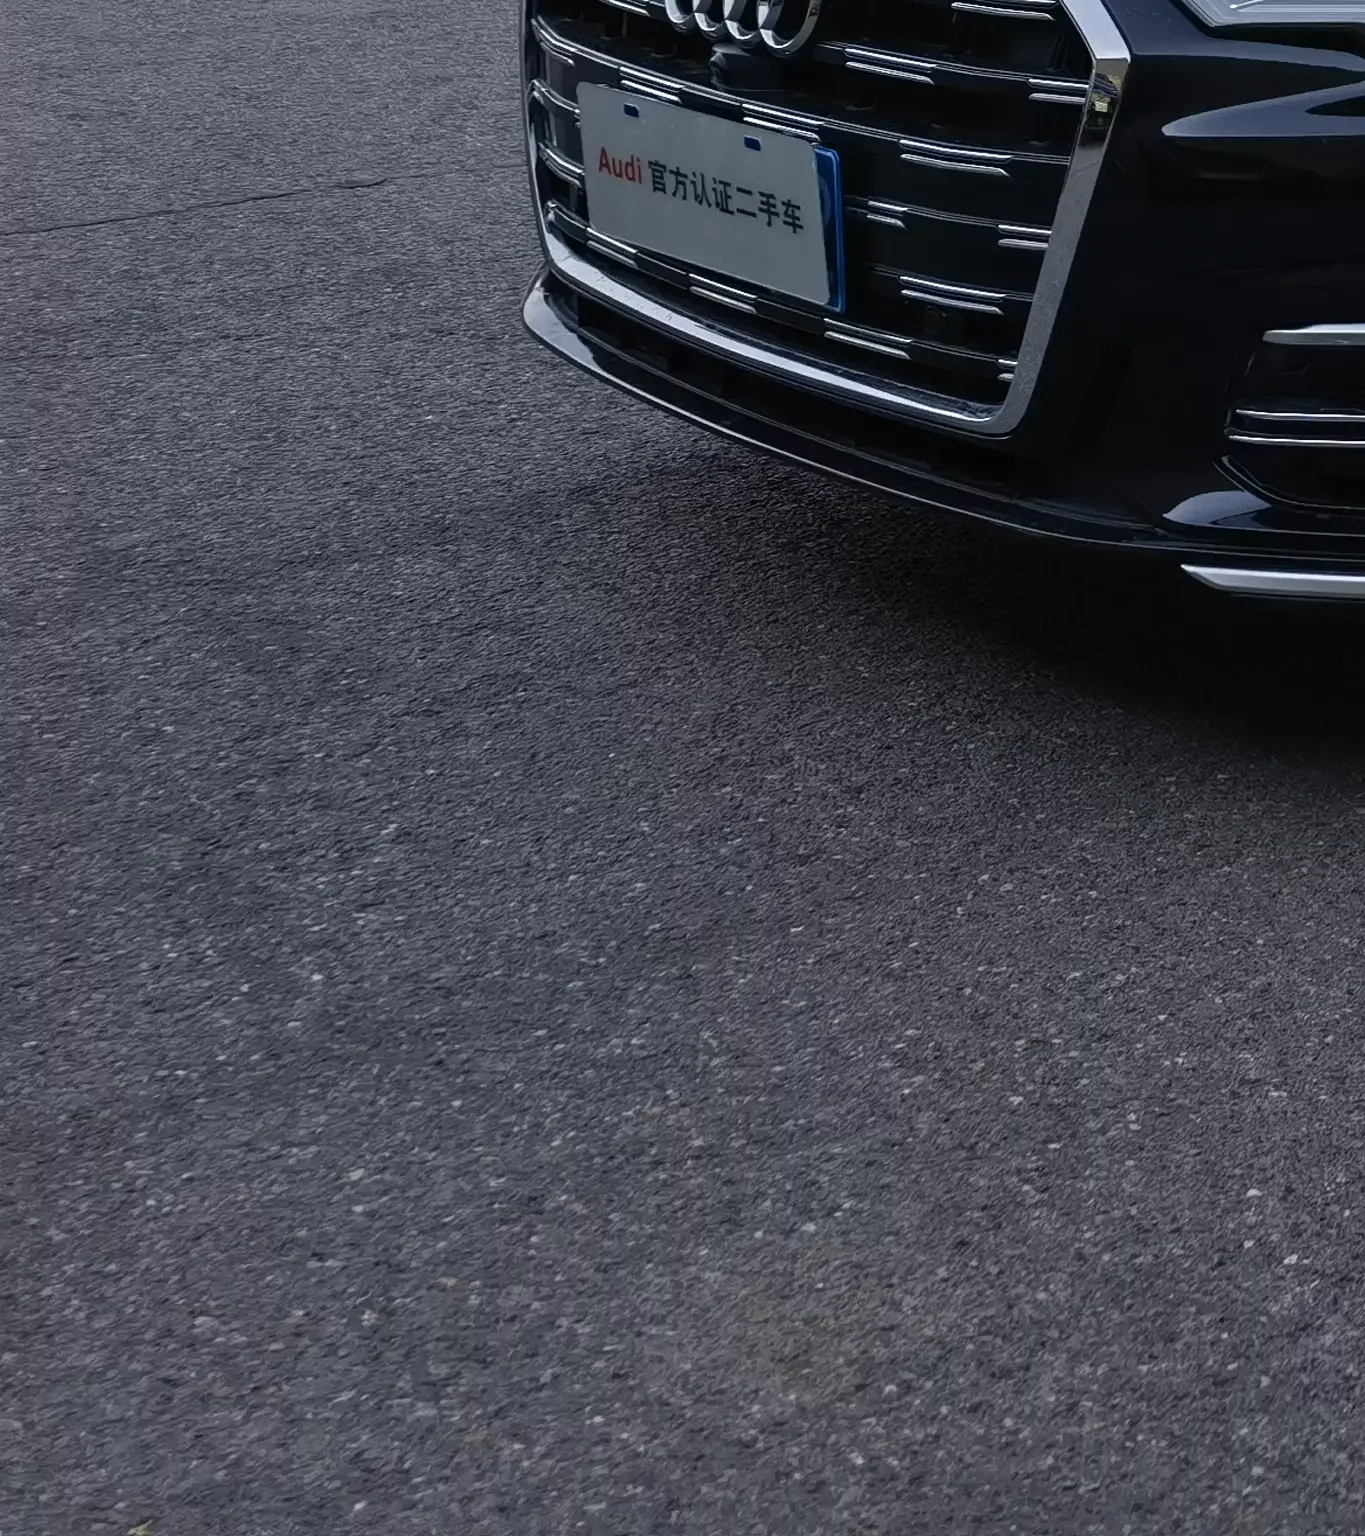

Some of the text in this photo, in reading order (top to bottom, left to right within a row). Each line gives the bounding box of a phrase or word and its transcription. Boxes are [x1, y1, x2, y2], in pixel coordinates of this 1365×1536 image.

[599, 146, 804, 234] Audi 官方认证二手车
